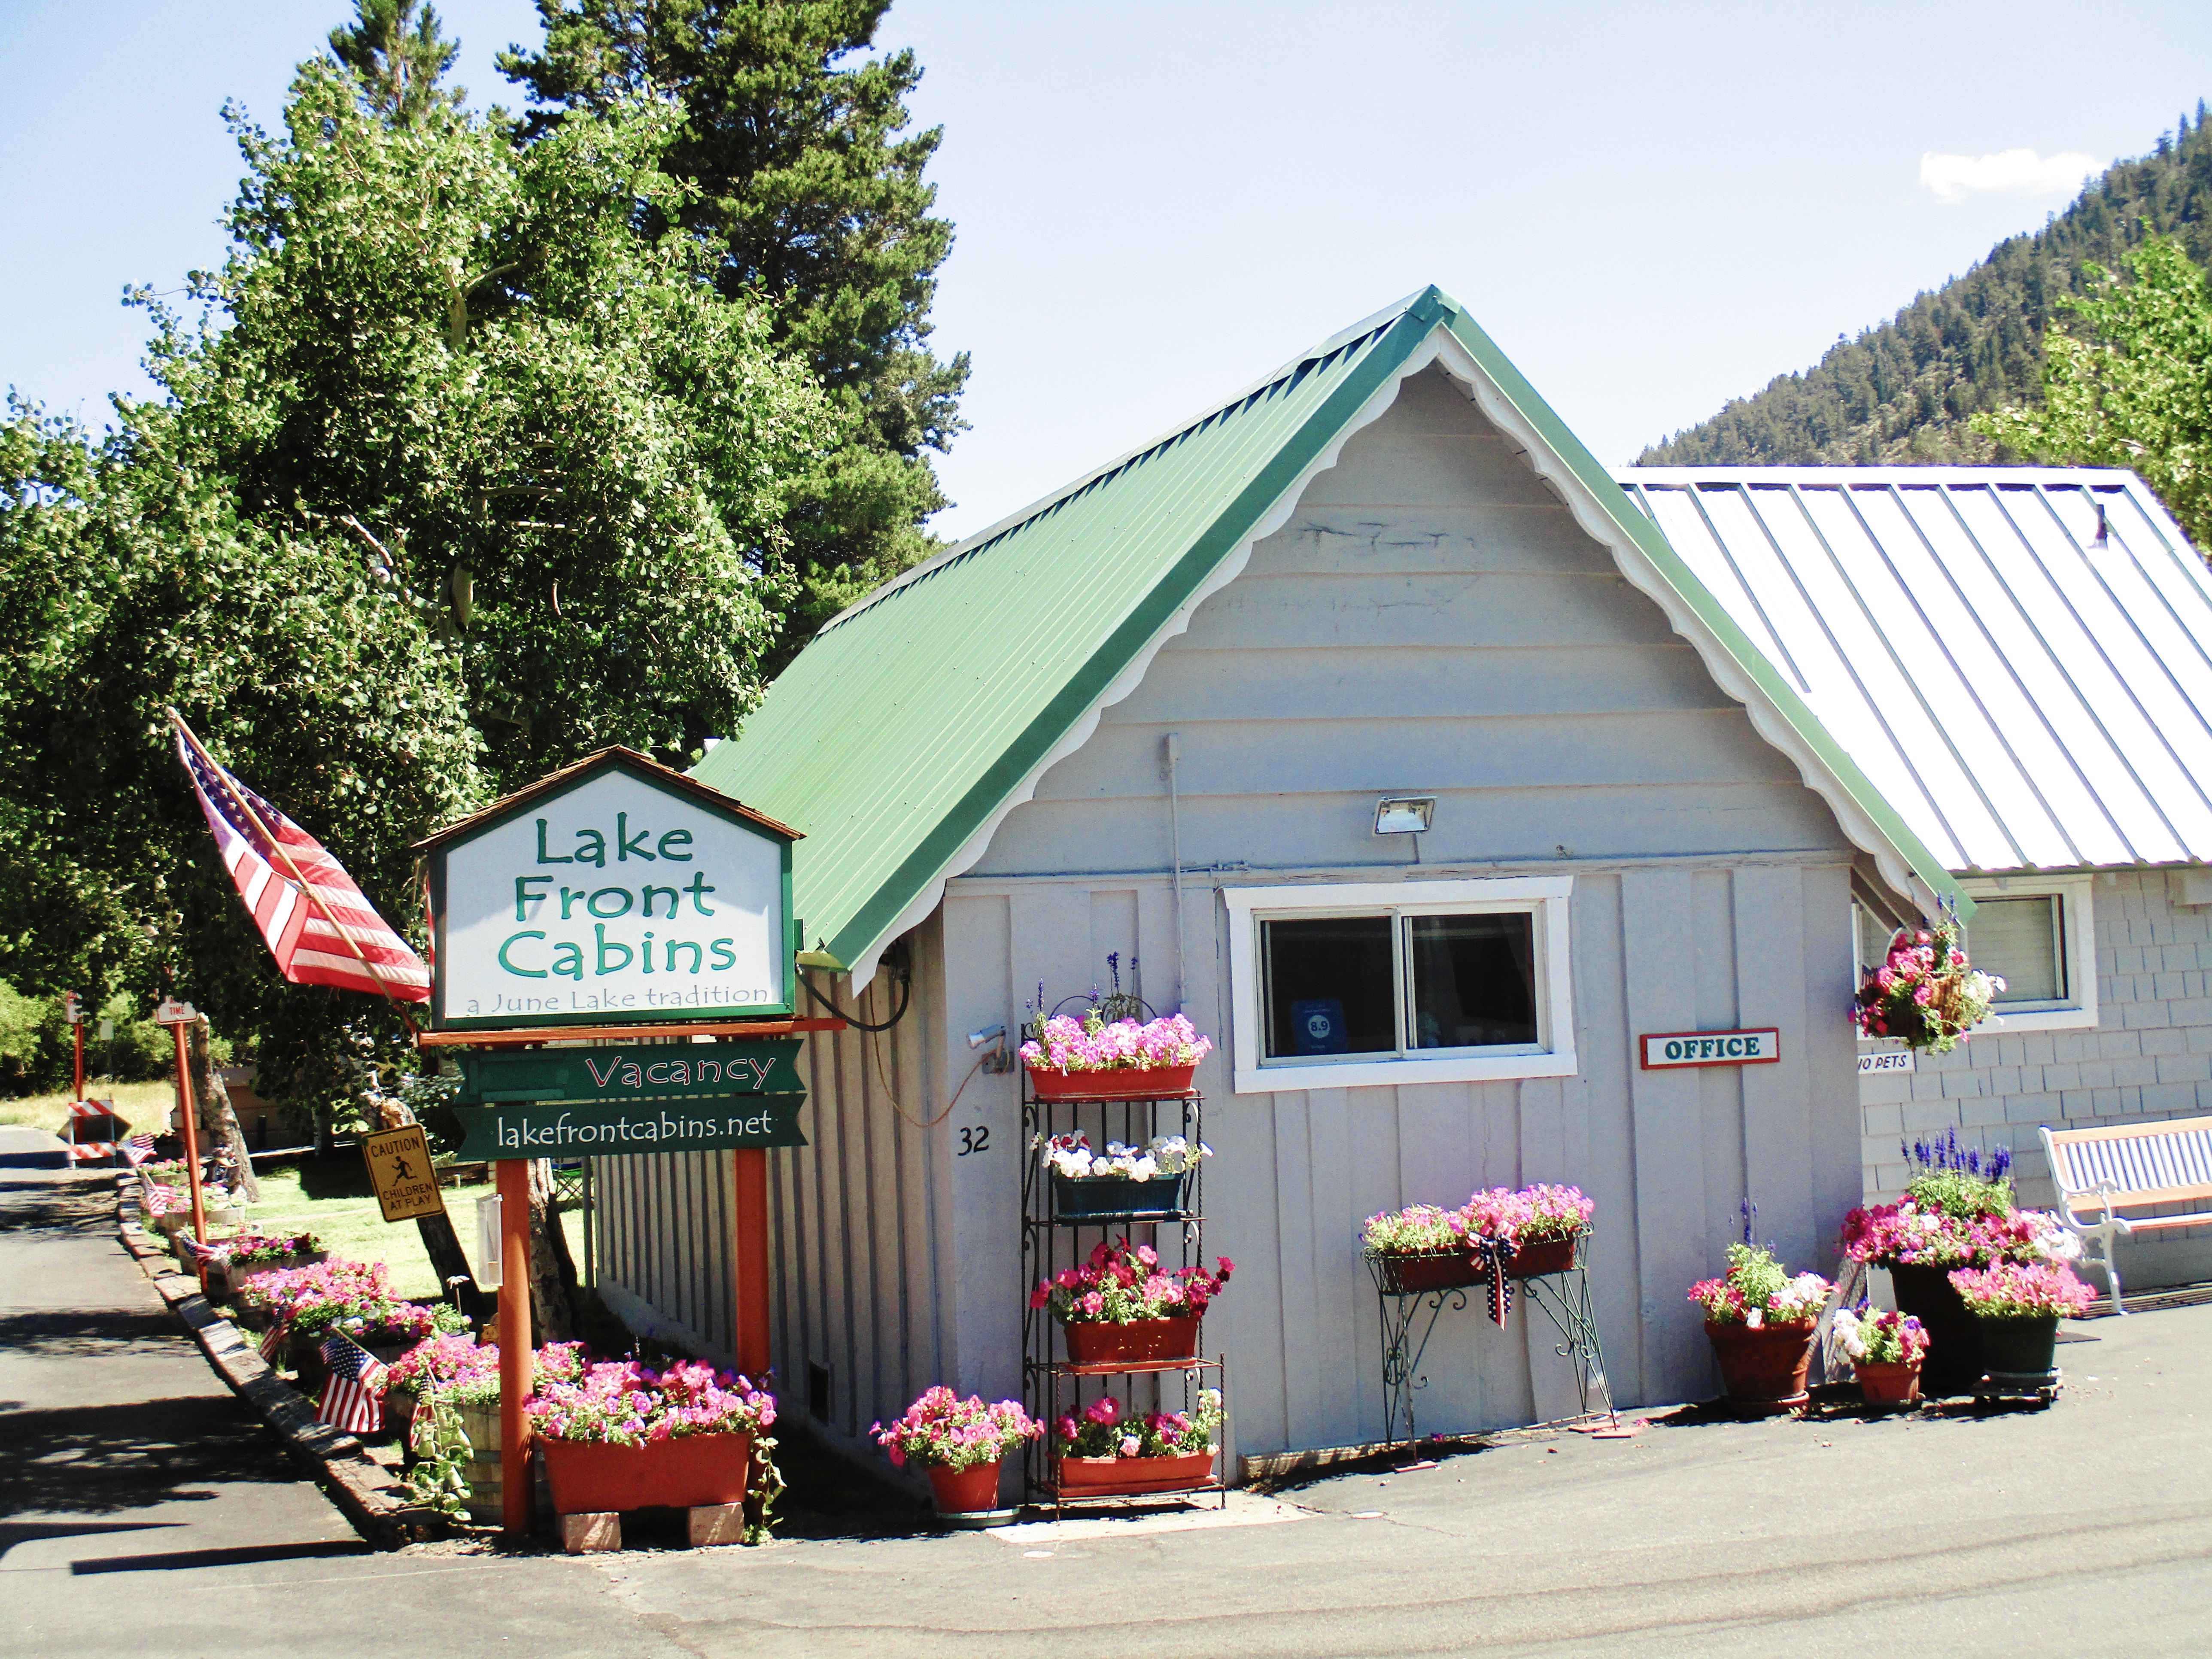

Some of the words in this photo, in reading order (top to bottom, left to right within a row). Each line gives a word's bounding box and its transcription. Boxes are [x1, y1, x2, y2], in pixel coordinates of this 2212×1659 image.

[536, 811, 693, 868] Lake
[515, 871, 715, 922] Front
[498, 923, 737, 981] Cabins
[169, 1006, 185, 1015] TIME
[468, 999, 480, 1014] a
[492, 994, 559, 1012] June
[572, 988, 635, 1011] Lake
[645, 985, 768, 1006] tradition
[1311, 1021, 1328, 1031] 8.9
[1665, 1037, 1760, 1060] OFFICE
[1875, 1054, 1907, 1069] PETS
[586, 1056, 776, 1089] Vacancy
[498, 1110, 772, 1149] lakefrontcabins.net
[958, 1126, 989, 1156] 32
[371, 1136, 420, 1158] CAUTION
[383, 1182, 434, 1200] CHILDREN
[390, 1200, 402, 1211] AT
[405, 1194, 431, 1207] PLAY
